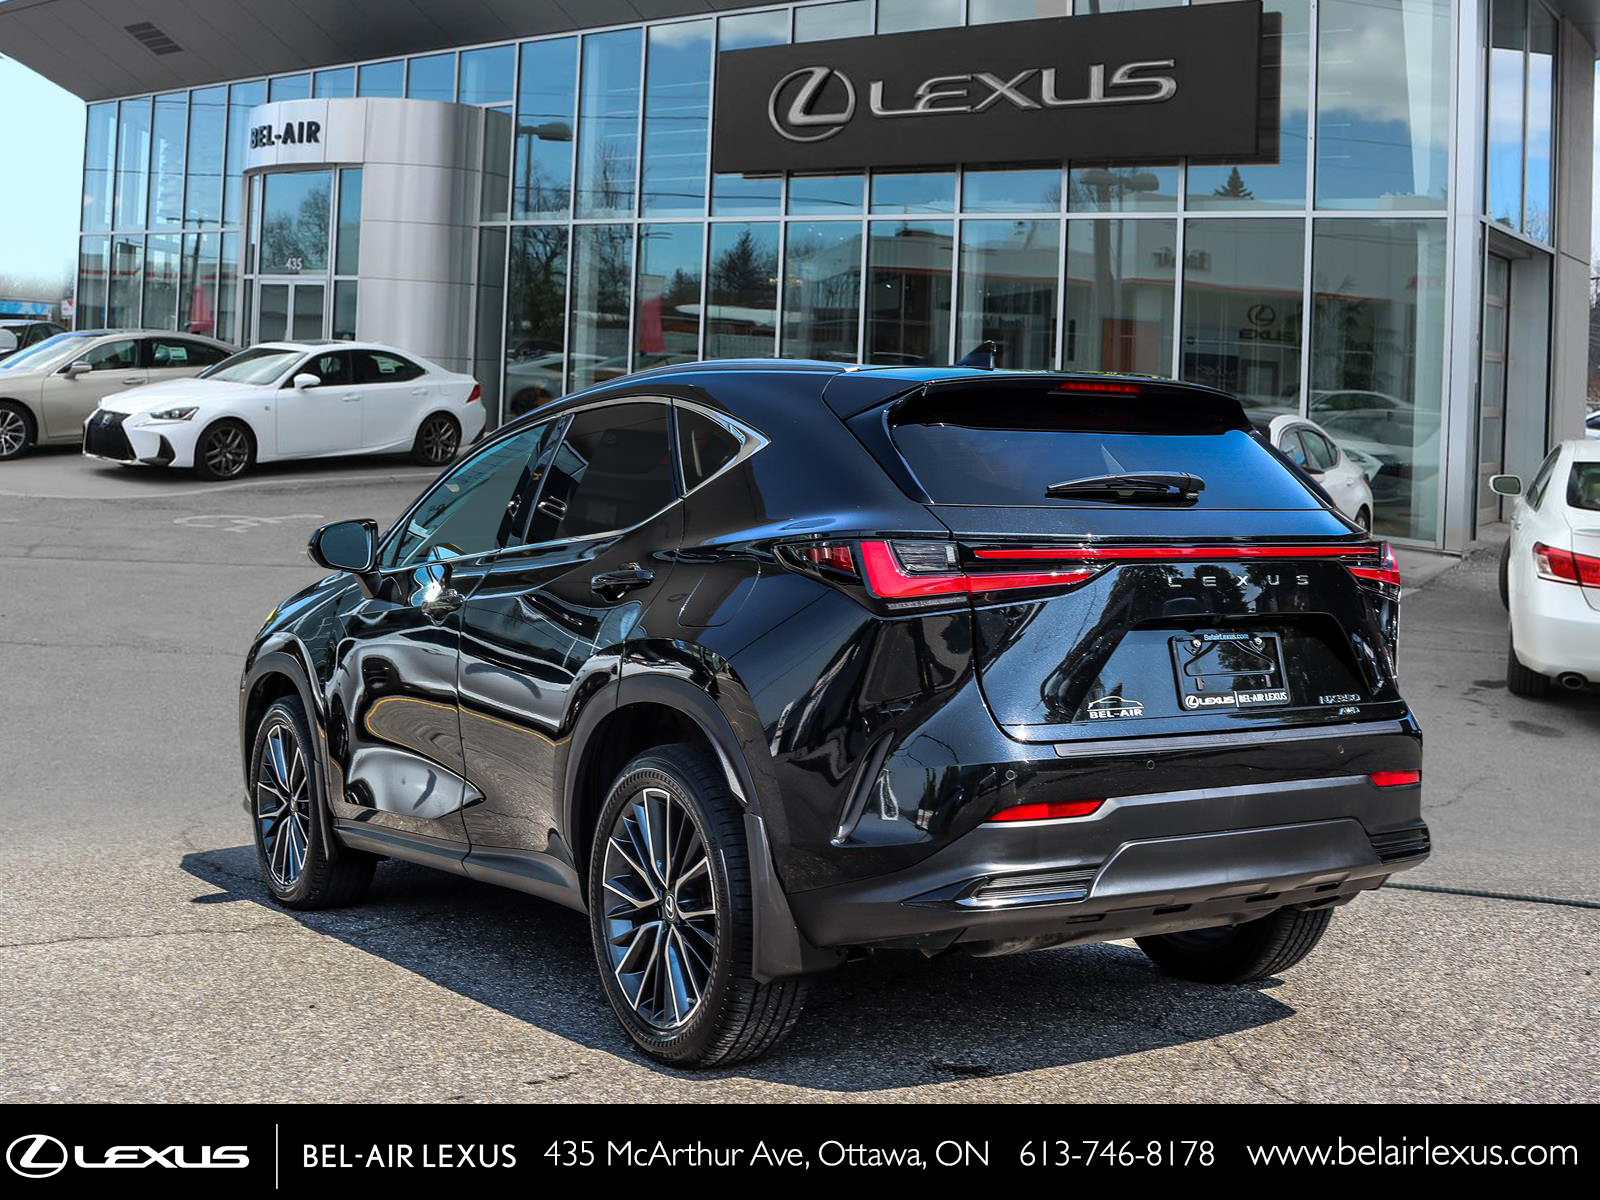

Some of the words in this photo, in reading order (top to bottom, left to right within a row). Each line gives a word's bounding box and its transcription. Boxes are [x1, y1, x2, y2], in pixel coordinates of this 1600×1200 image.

[869, 59, 1177, 118] LEXUS
[250, 121, 321, 149] BEL-AIR
[286, 257, 303, 270] 435
[1167, 574, 1310, 588] LEXUS
[1199, 696, 1236, 706] LEXUS
[1238, 693, 1265, 704] BEL-AIR
[1265, 691, 1288, 701] LEXUS
[1089, 708, 1143, 719] BEL-AIR
